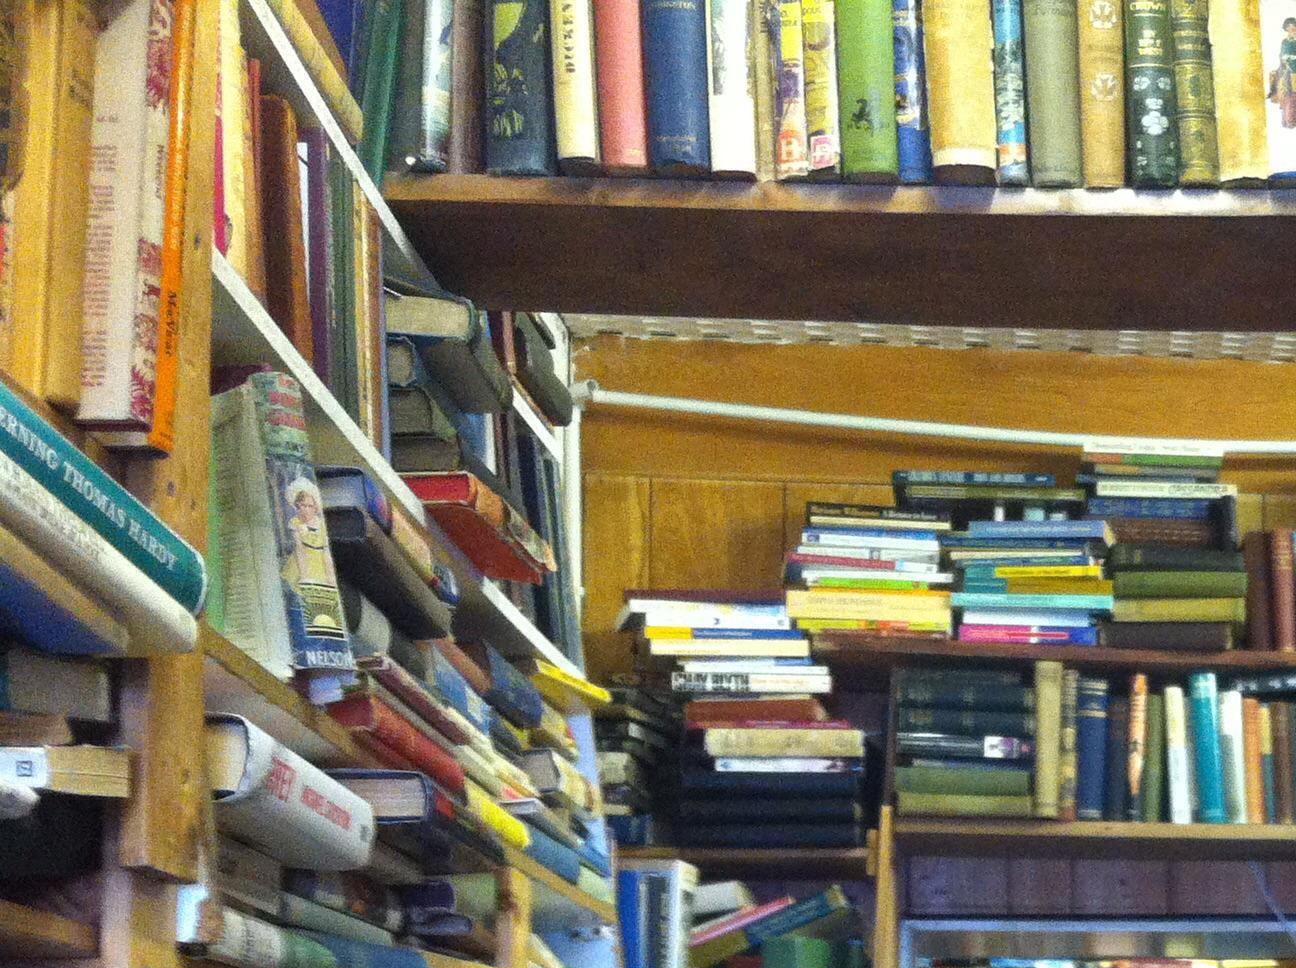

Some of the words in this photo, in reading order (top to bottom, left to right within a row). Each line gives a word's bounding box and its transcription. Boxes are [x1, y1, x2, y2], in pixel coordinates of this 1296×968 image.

[62, 460, 127, 528] THOMAS
[127, 518, 177, 571] HARDY
[305, 649, 354, 671] NELSON
